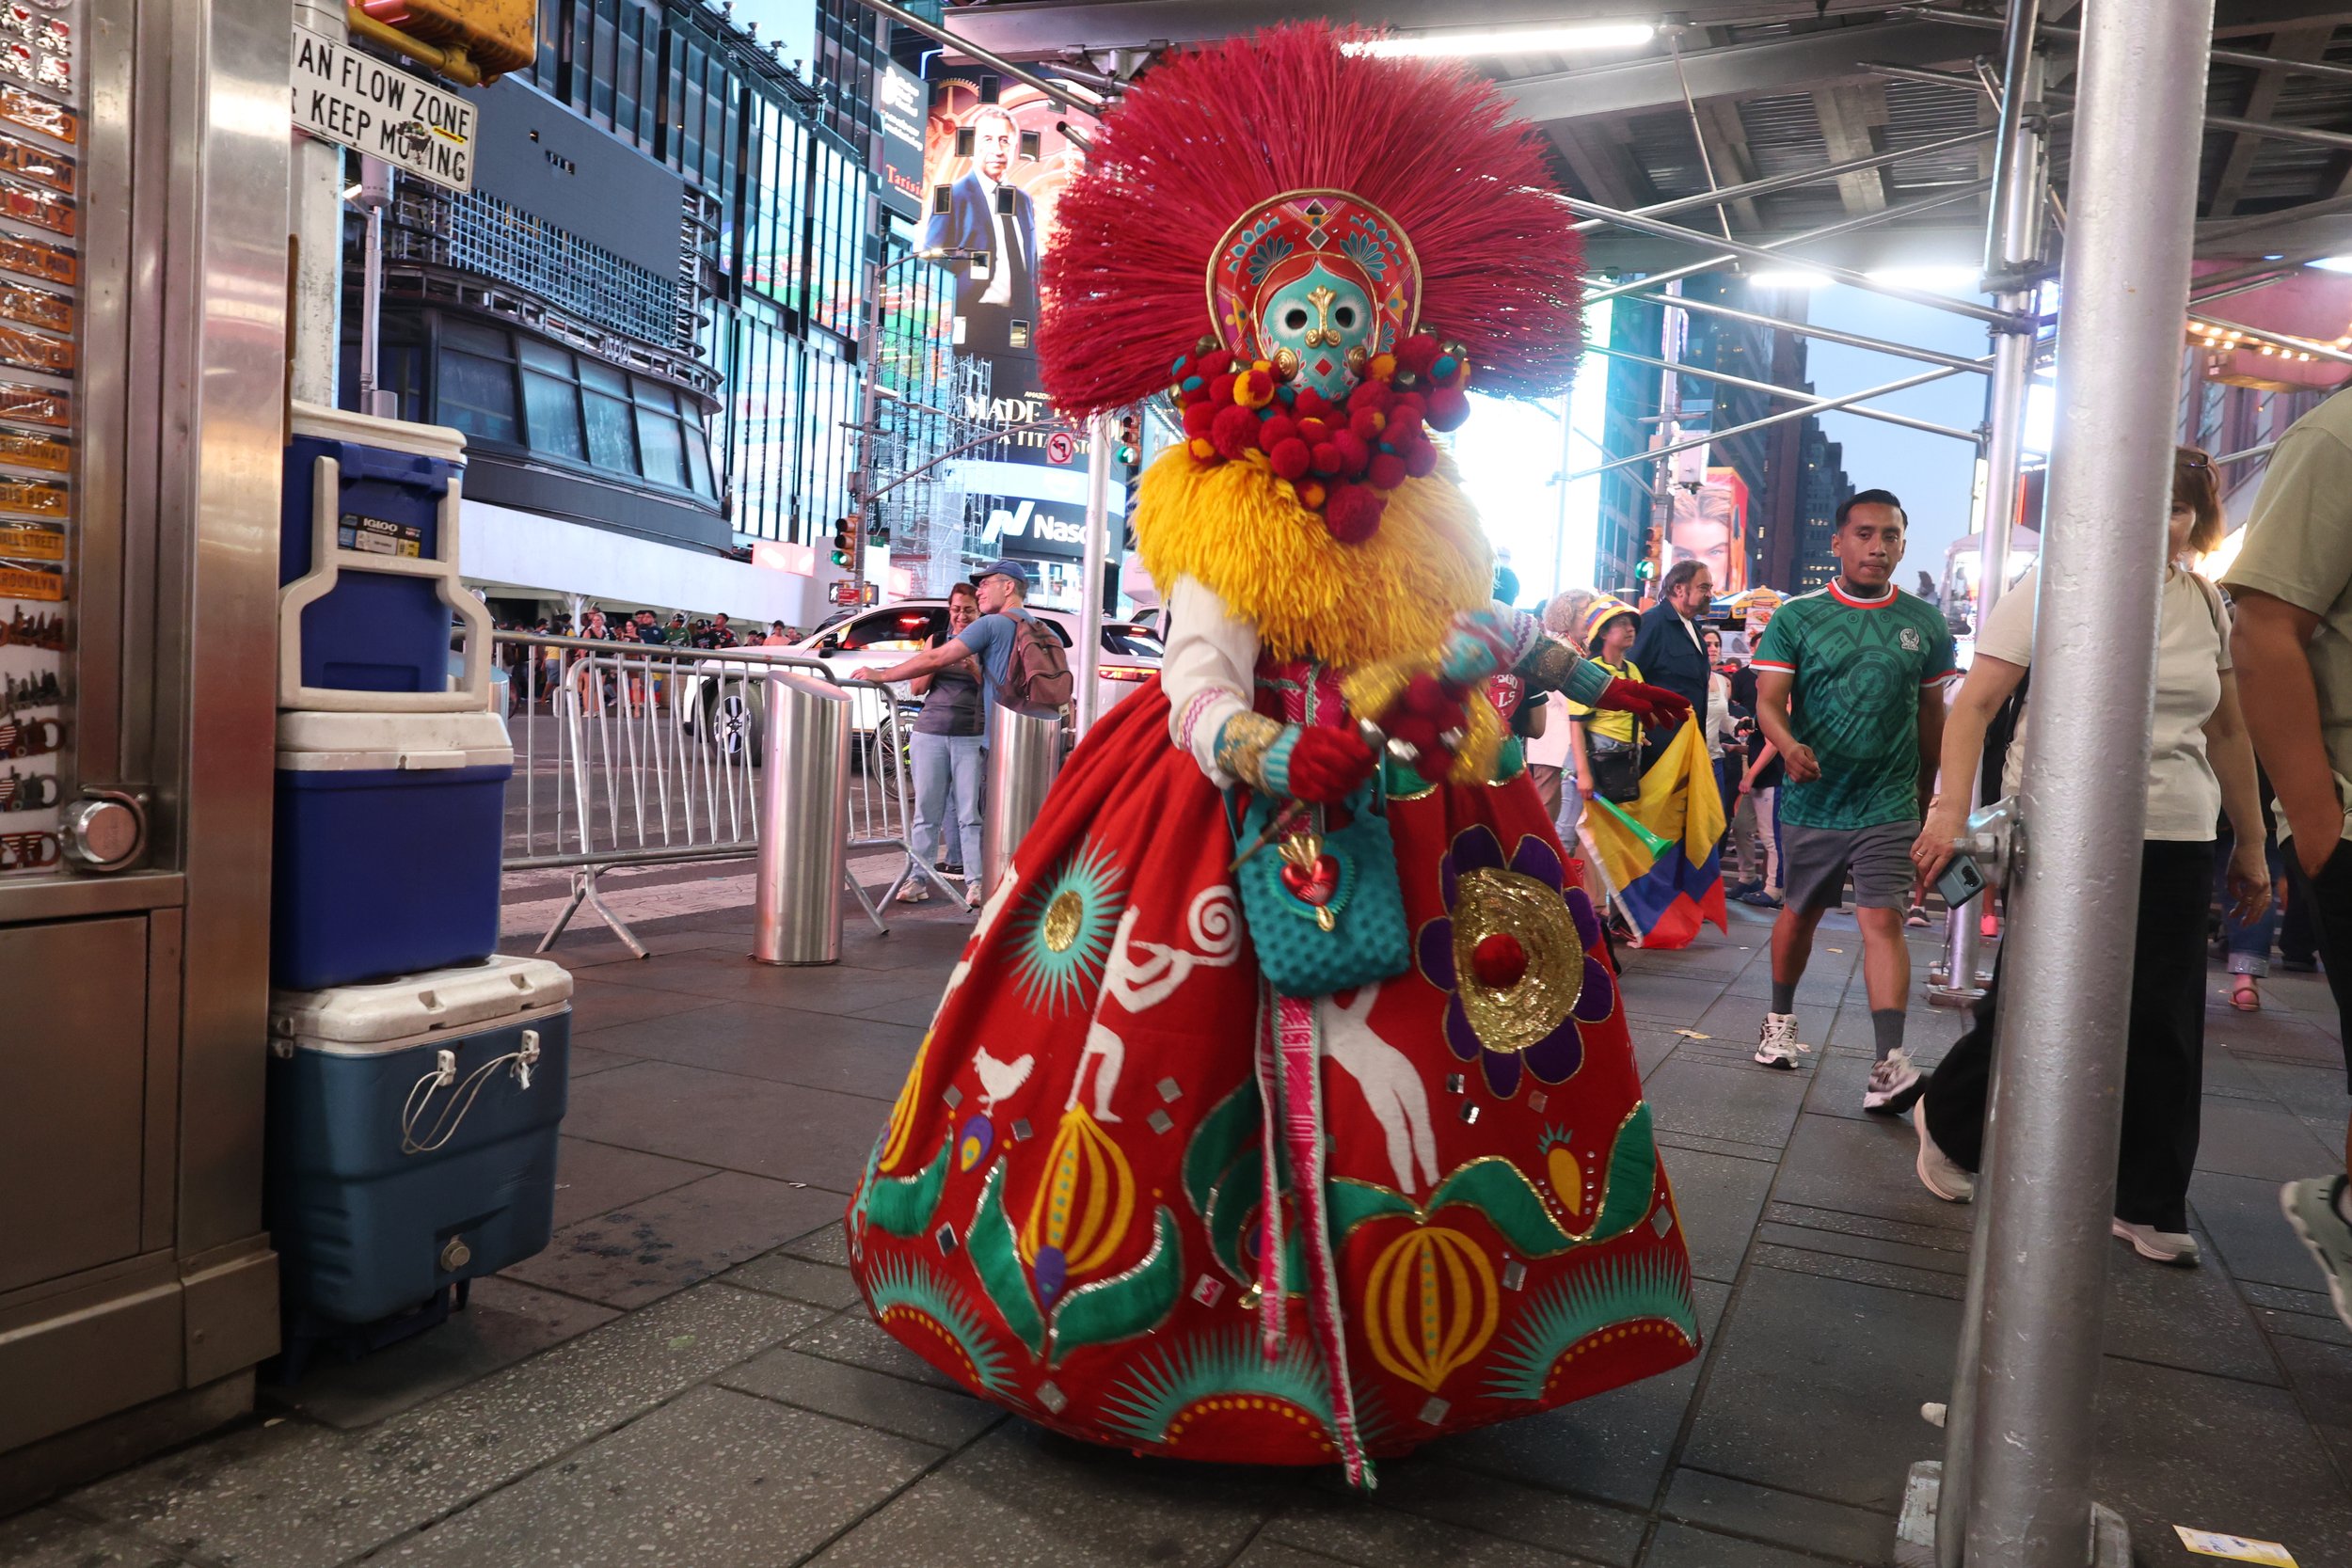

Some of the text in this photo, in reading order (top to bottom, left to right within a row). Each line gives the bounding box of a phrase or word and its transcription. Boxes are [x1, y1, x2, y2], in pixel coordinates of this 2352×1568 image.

[310, 89, 372, 140] KEEP
[380, 119, 466, 182] MOING
[342, 55, 405, 111] FLOW
[412, 88, 470, 141] ZONE
[964, 395, 1043, 424] MADE
